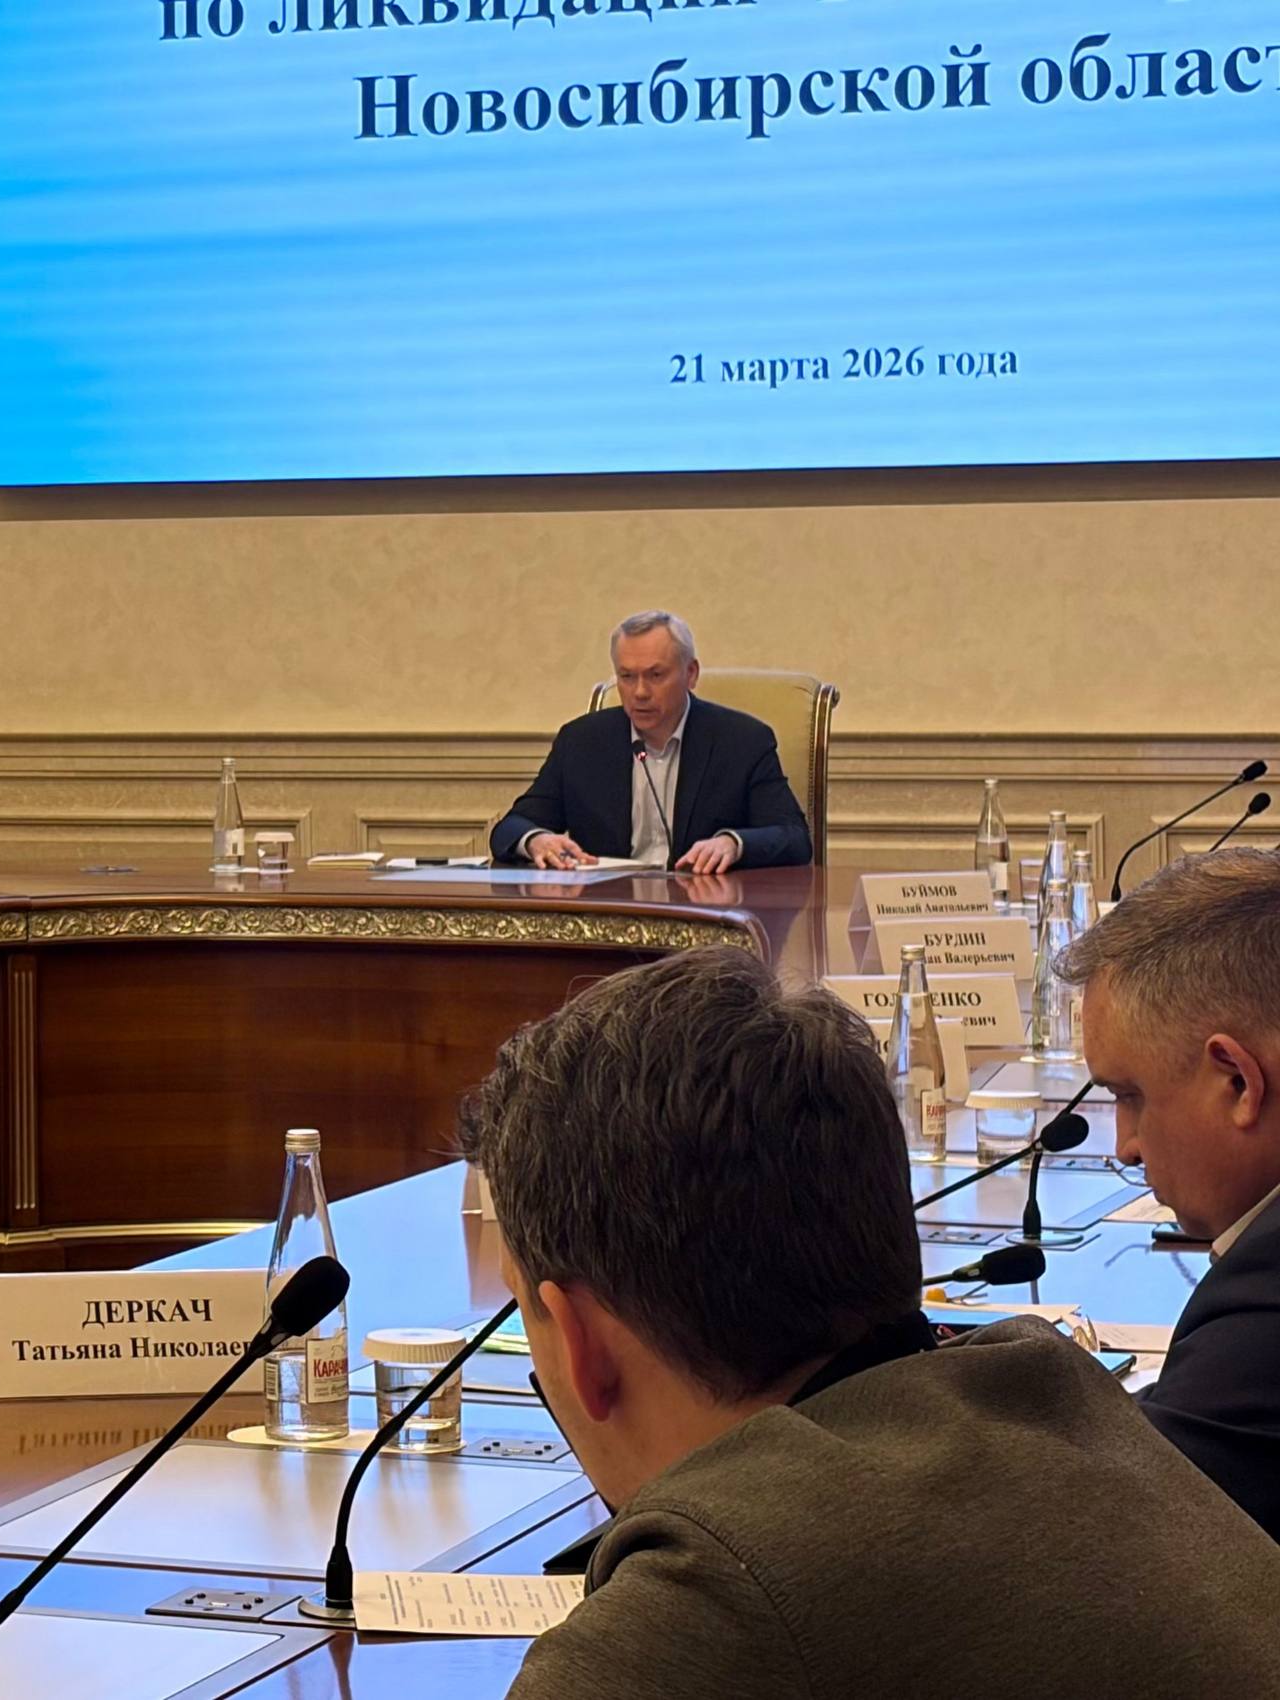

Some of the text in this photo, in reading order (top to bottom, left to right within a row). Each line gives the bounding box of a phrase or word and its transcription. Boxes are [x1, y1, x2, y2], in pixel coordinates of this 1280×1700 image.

[160, 0, 244, 40] по
[353, 43, 992, 141] Новосибирской
[670, 346, 1018, 389] 21 марта 2026 года
[902, 885, 958, 898] БУЙМОВ
[924, 932, 986, 947] БУРДИН
[945, 951, 1015, 966] Валерьевич
[81, 1298, 213, 1330] ДЕРКАЧ
[12, 1339, 121, 1361] Татьяна
